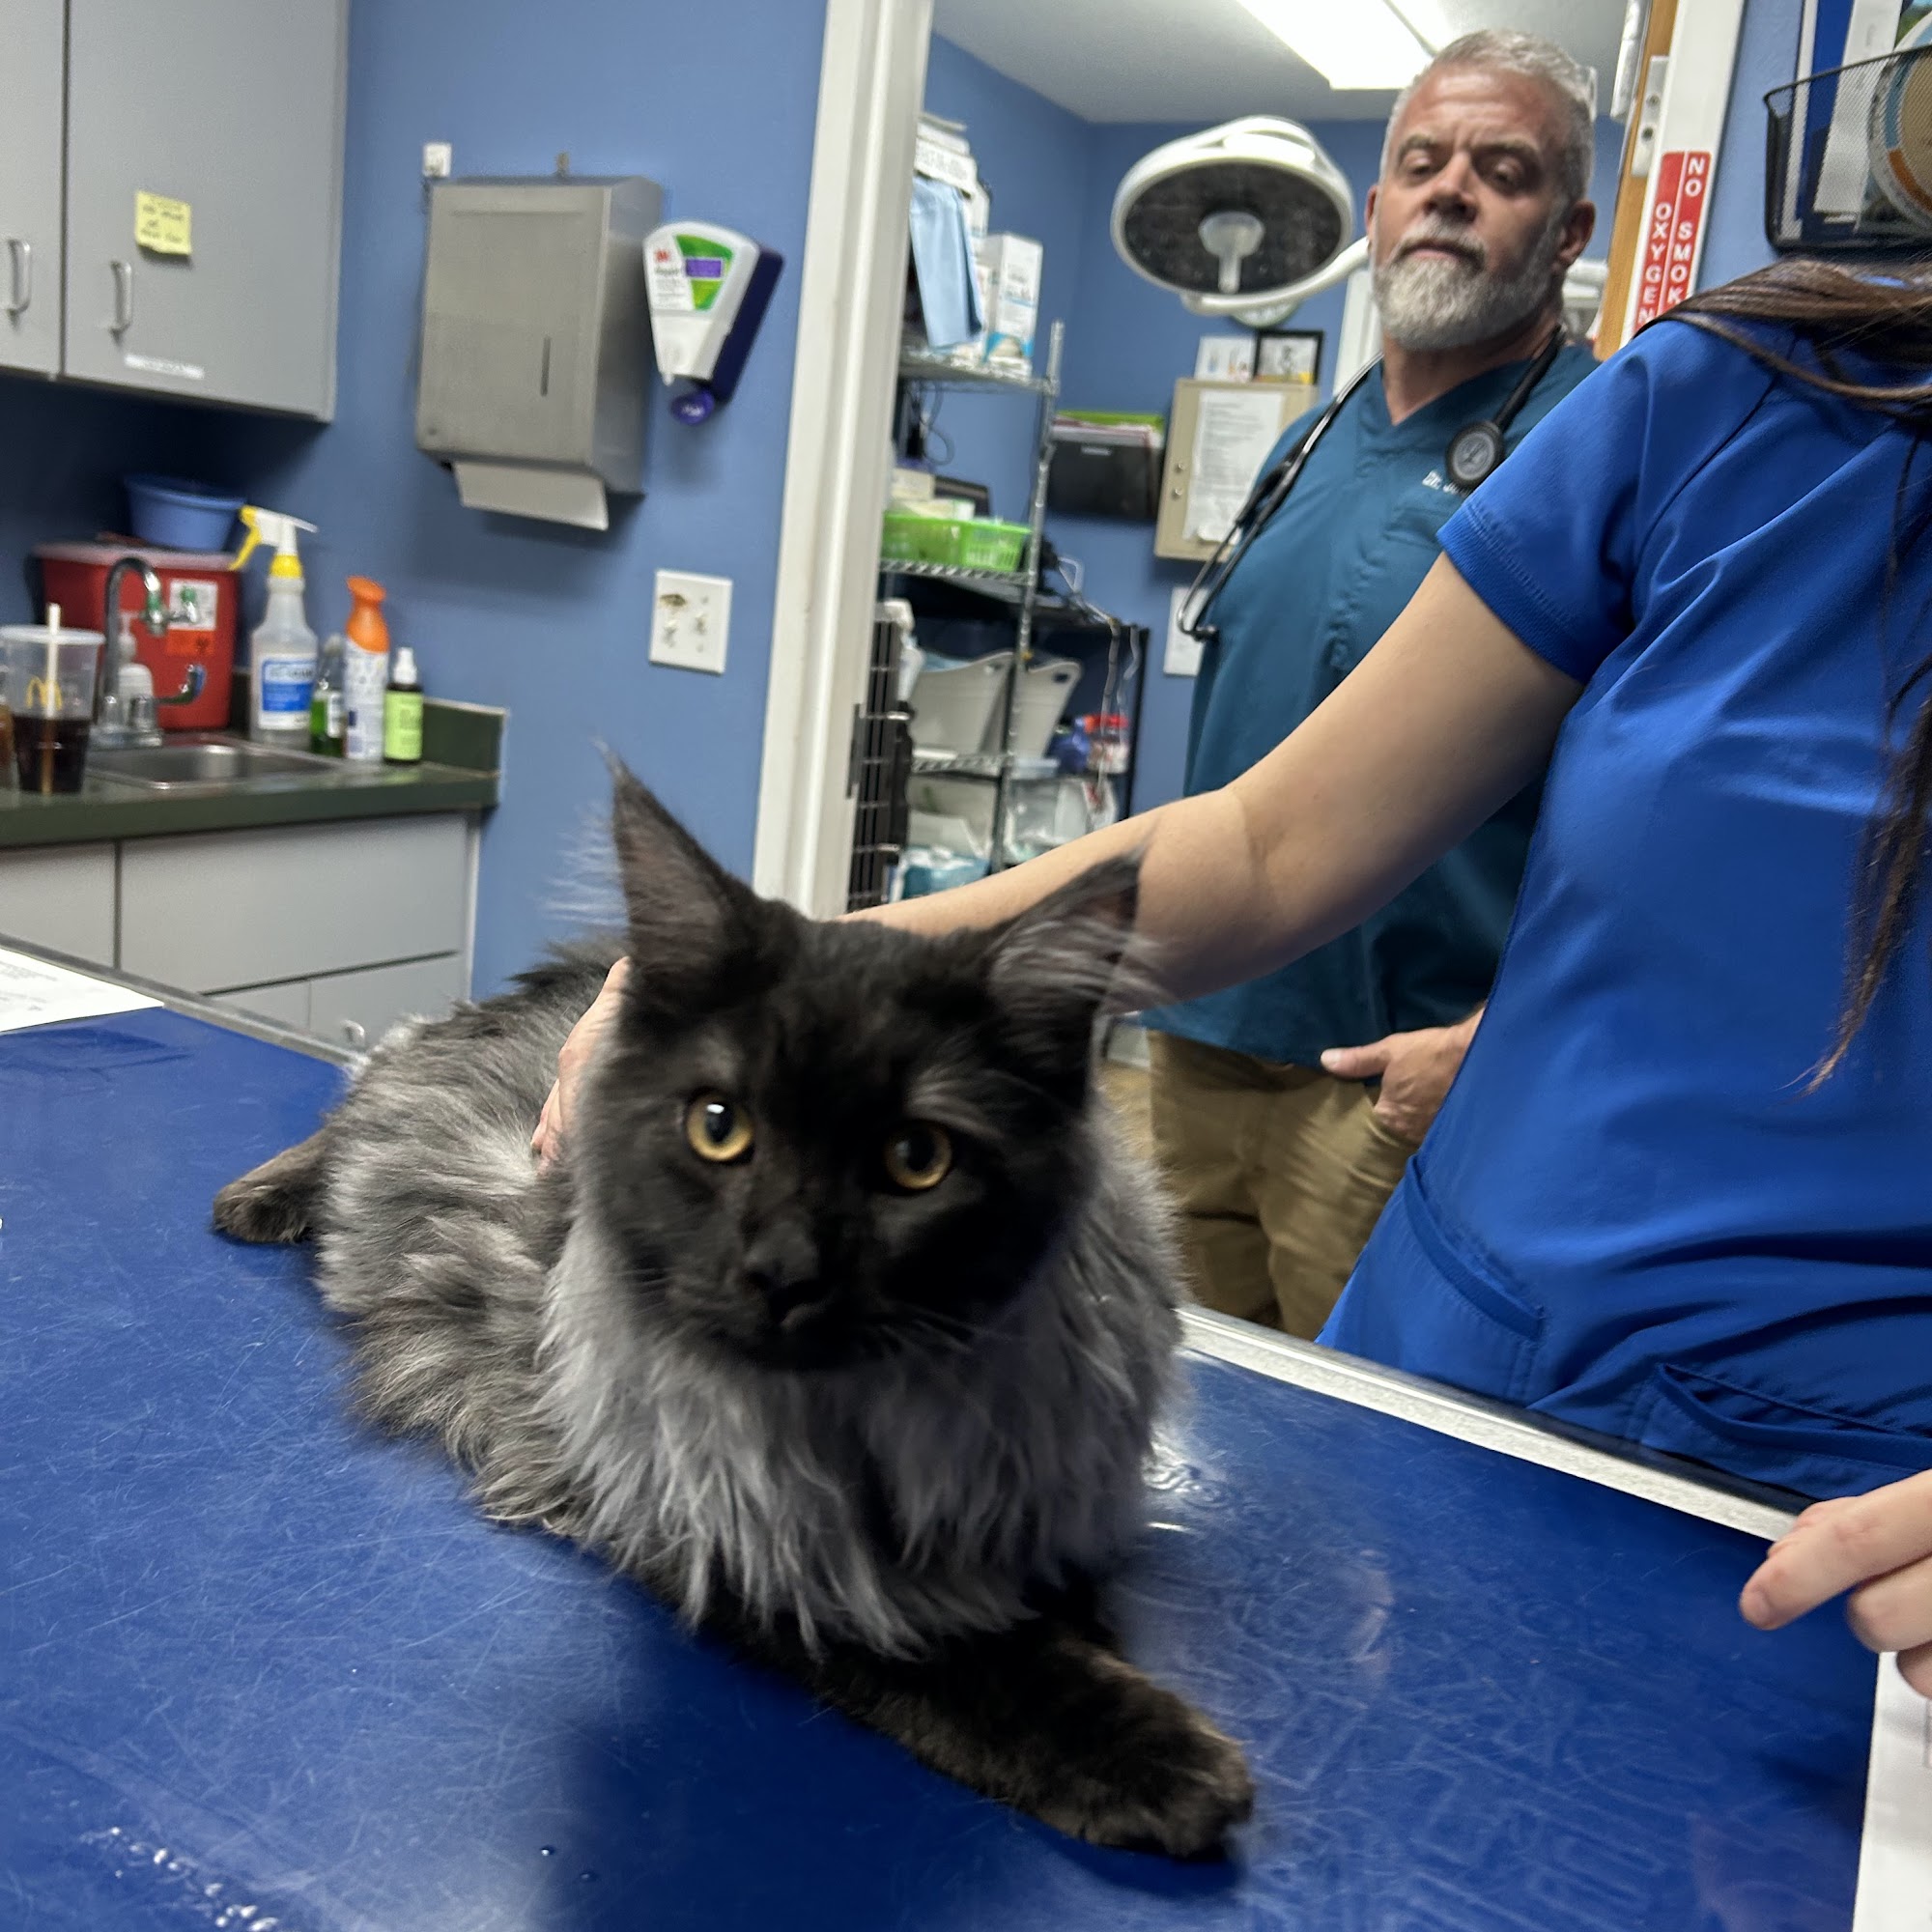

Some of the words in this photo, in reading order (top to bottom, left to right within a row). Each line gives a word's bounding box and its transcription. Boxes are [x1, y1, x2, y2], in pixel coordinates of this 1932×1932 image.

[1685, 157, 1705, 196] NO
[1638, 203, 1673, 323] OXYGEN
[1668, 222, 1693, 304] SMOK
